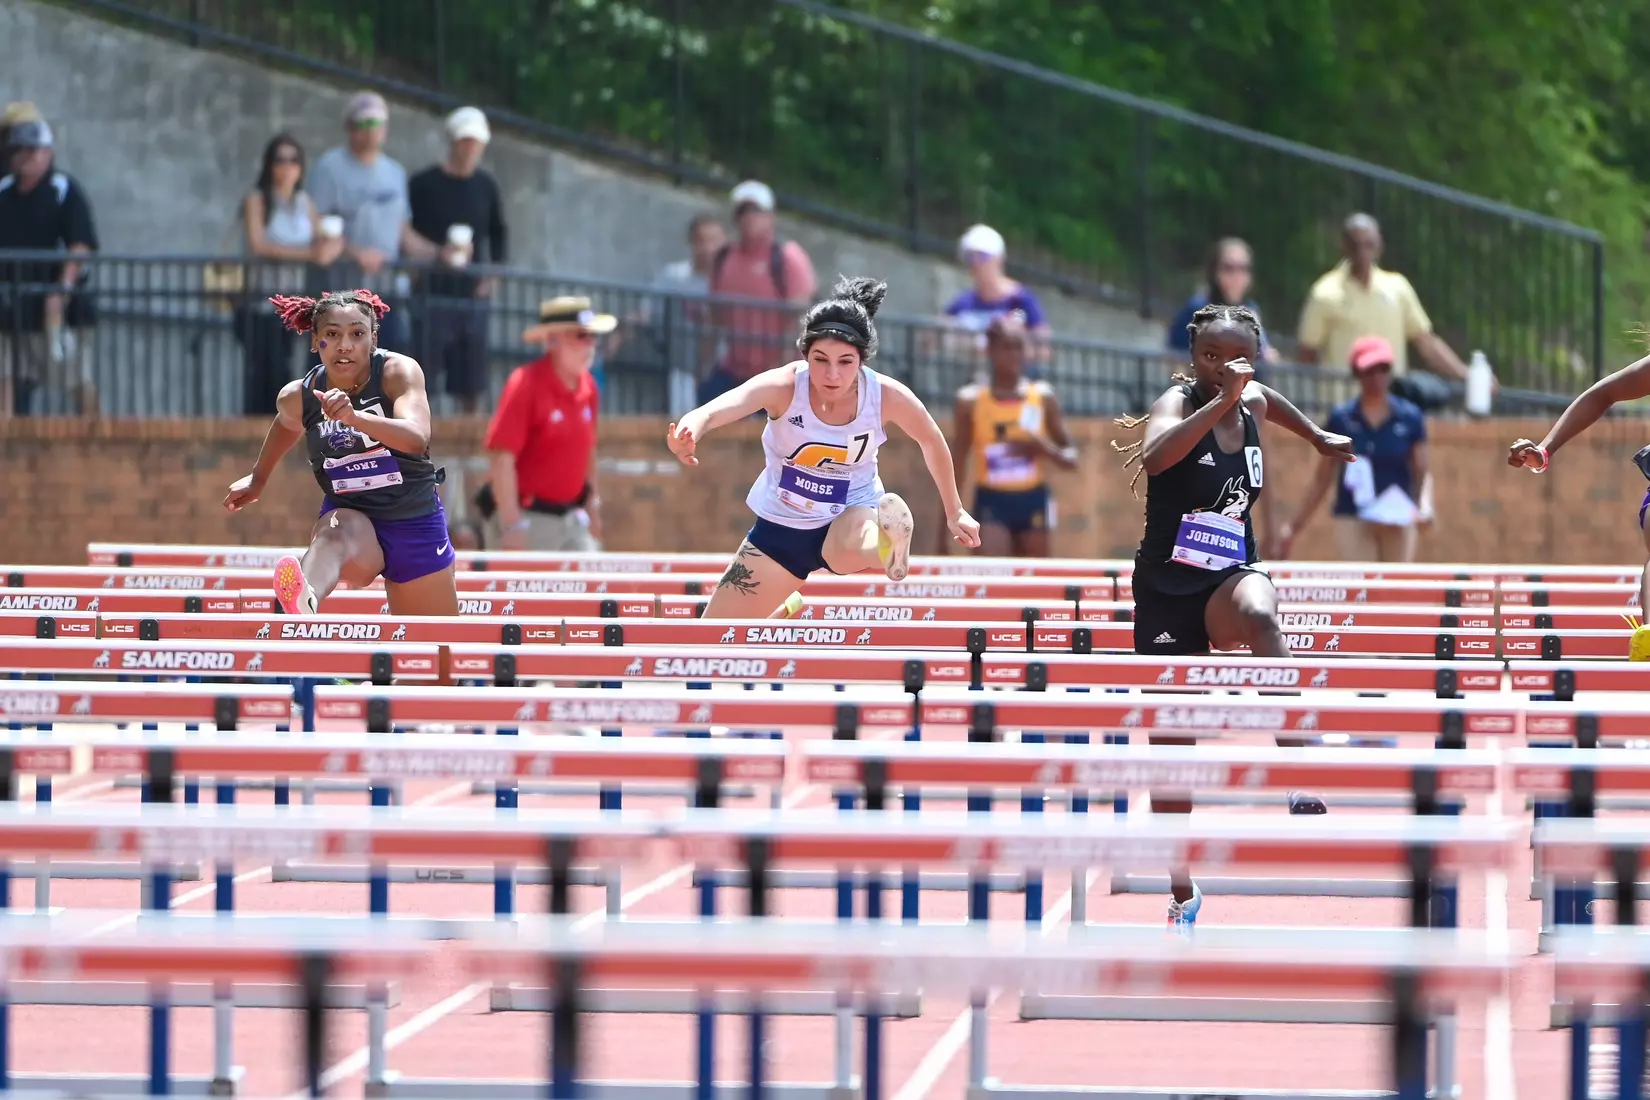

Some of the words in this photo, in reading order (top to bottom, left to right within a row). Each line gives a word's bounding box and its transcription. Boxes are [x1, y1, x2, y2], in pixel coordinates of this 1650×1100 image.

[854, 433, 869, 463] 7
[1252, 450, 1260, 485] 6
[795, 476, 834, 495] MORSE
[1186, 530, 1238, 551] JOHNSON
[124, 575, 205, 590] SAMFORD
[505, 580, 588, 593] SAMFORD
[884, 585, 966, 597] SAMFORD
[1275, 588, 1347, 601] AMFORD
[0, 595, 78, 610] AMFORD
[244, 601, 270, 609] UCS
[623, 605, 649, 613] UCS
[665, 607, 691, 615] UCS
[823, 606, 913, 620] SAMFORD
[1463, 619, 1488, 627] UCS
[1504, 618, 1530, 626] UCS
[61, 623, 90, 632] UCS
[105, 625, 134, 633] UCS
[281, 623, 381, 639] SAMFORD
[526, 630, 556, 638] UCS
[569, 630, 599, 638] UCS
[746, 627, 846, 643] SAMFORD
[992, 633, 1021, 642] UCS
[1037, 633, 1067, 642] UCS
[1460, 640, 1489, 649] UCS
[1506, 641, 1536, 650] UCS
[121, 651, 235, 669] SAMFORD
[397, 659, 432, 669] UCS
[454, 660, 489, 669] UCS
[653, 658, 768, 676] SAMFORD
[930, 667, 965, 676] UCS
[986, 667, 1021, 677] UCS
[1185, 667, 1300, 686] SAMFORD
[1462, 676, 1497, 686] UCS
[1513, 676, 1549, 686] UCS
[547, 700, 680, 722] SAMFORD
[1155, 707, 1286, 729] SAMFORD
[416, 868, 464, 880] UCS
